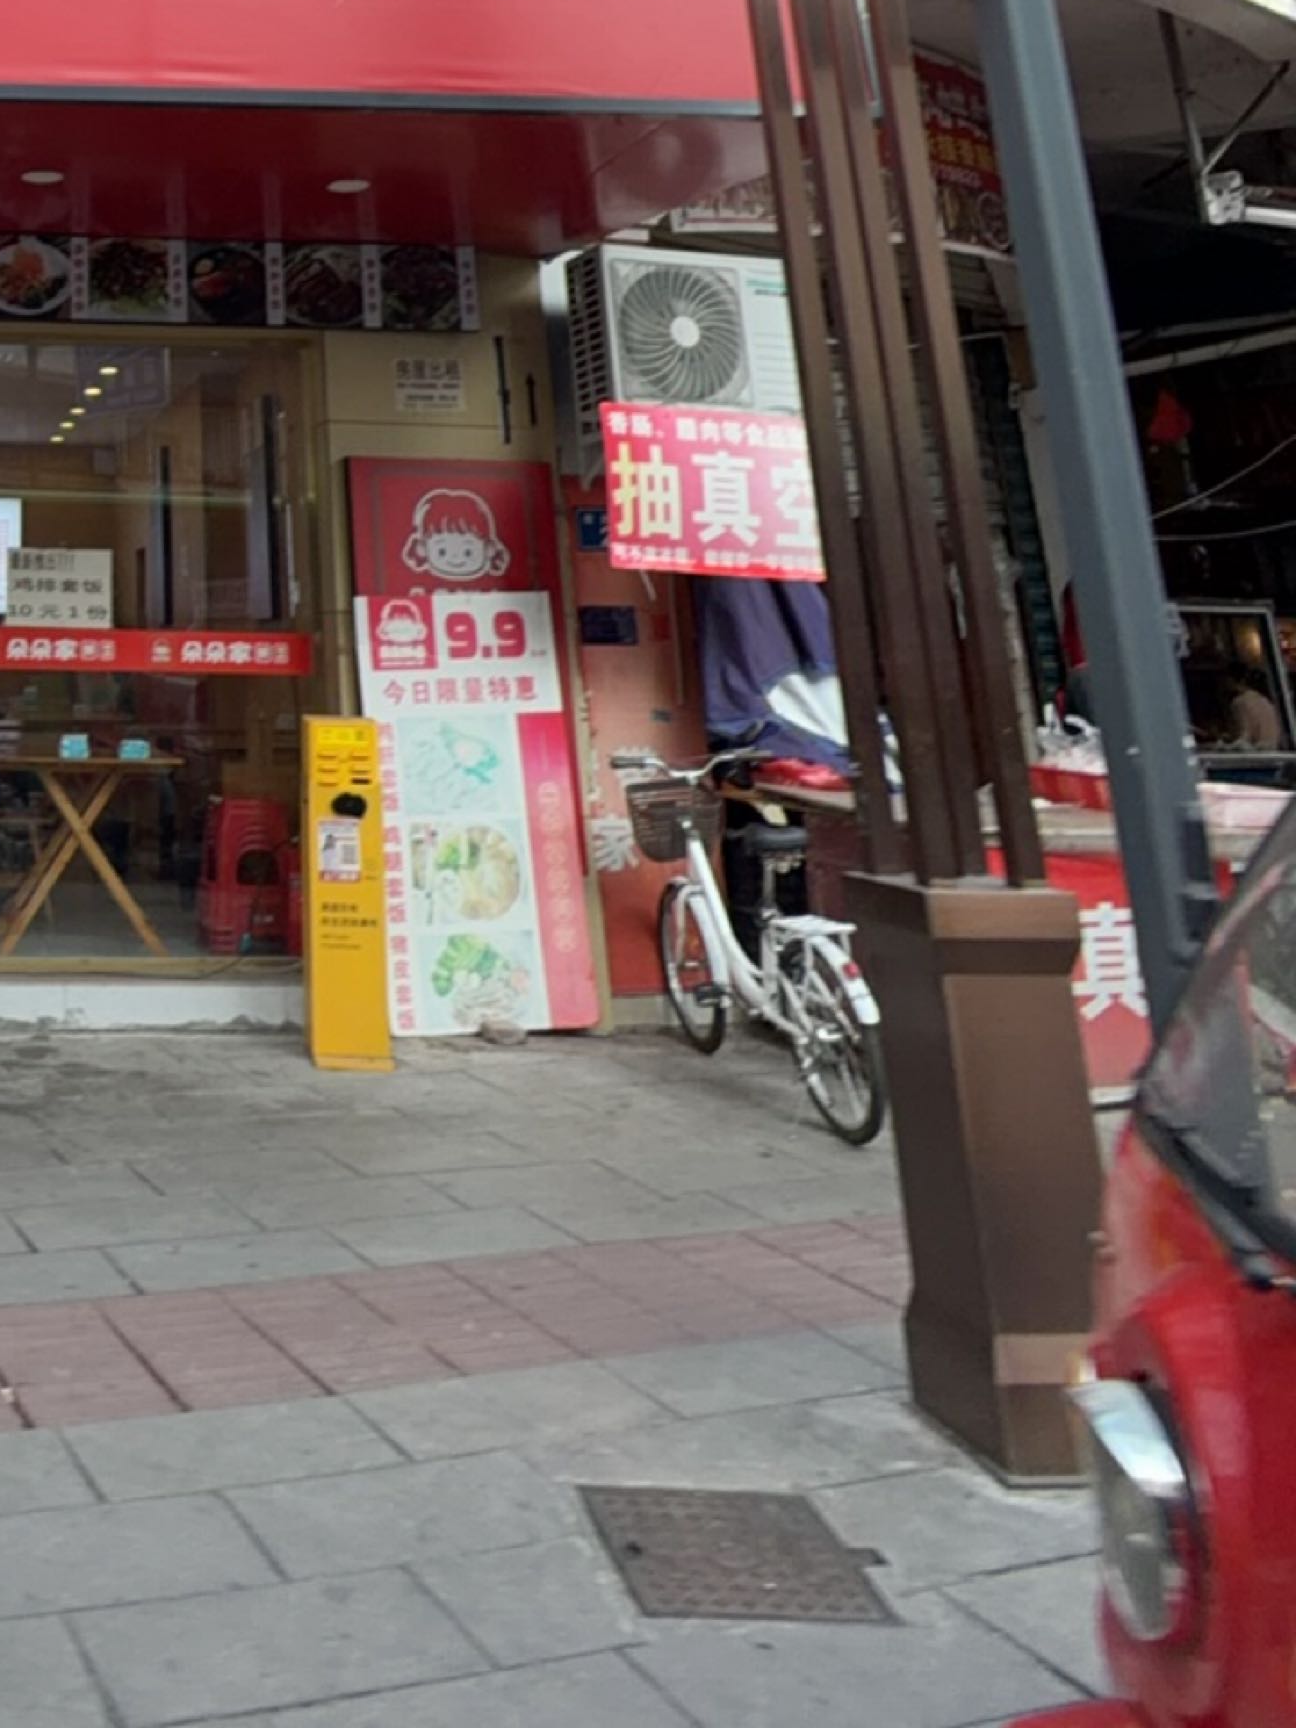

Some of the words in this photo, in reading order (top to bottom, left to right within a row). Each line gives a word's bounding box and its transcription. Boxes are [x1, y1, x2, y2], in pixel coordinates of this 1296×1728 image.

[610, 442, 819, 549] 抽真空
[445, 611, 527, 660] 9.9
[383, 675, 539, 706] 今日限量特惠
[1071, 902, 1151, 1020] 真
